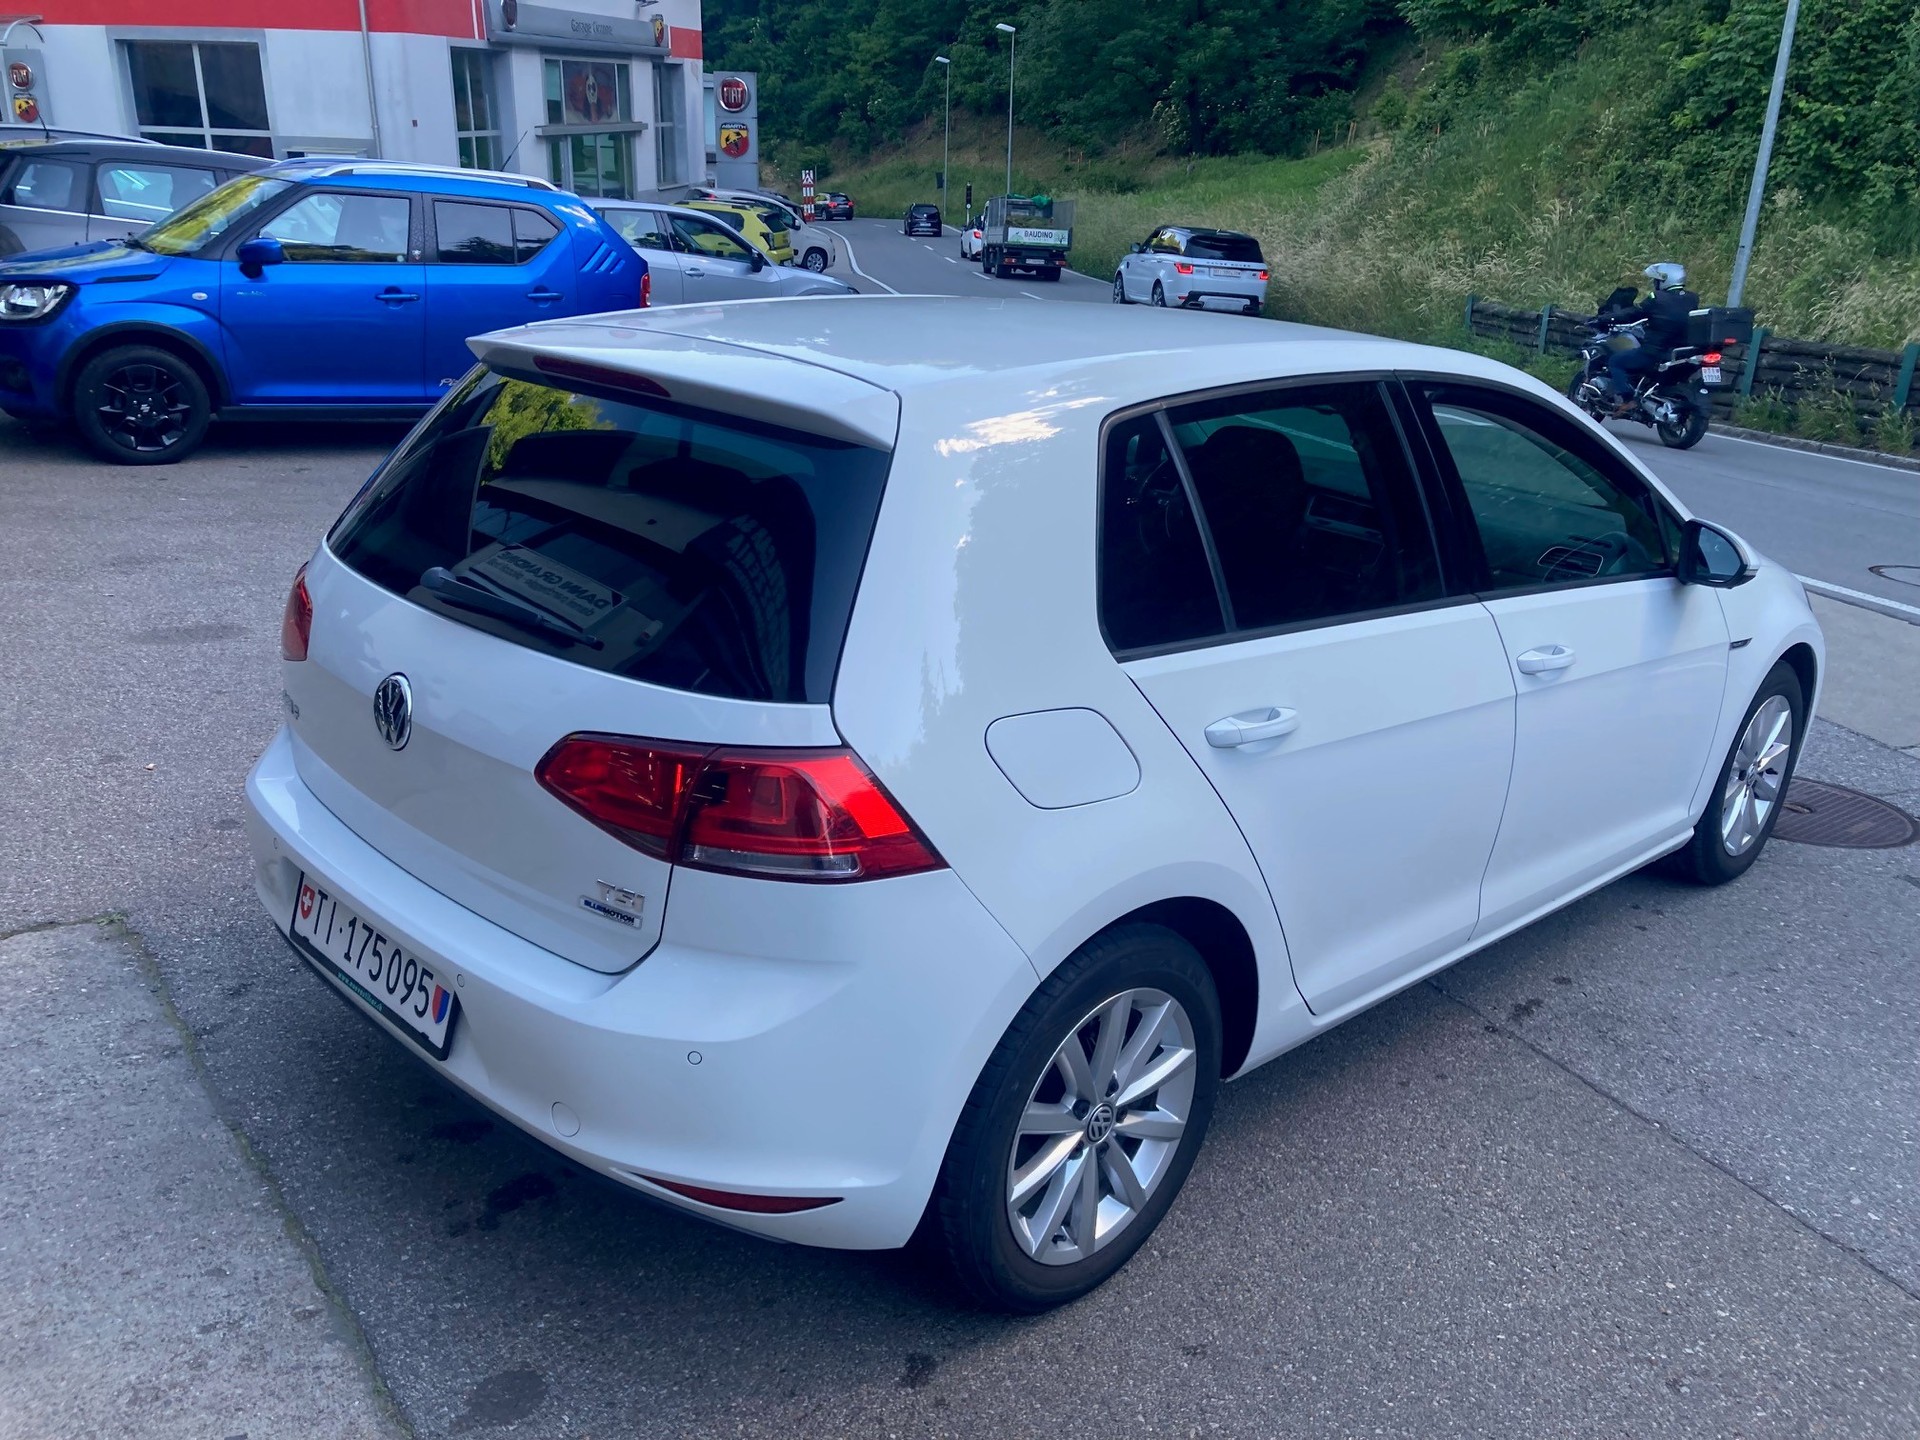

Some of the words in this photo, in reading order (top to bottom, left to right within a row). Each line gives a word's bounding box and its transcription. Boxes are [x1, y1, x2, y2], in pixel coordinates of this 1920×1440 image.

[723, 87, 743, 103] FIAT
[1024, 230, 1053, 239] BAUDINO
[596, 878, 646, 914] TSI
[583, 899, 635, 923] BLUEMOTION
